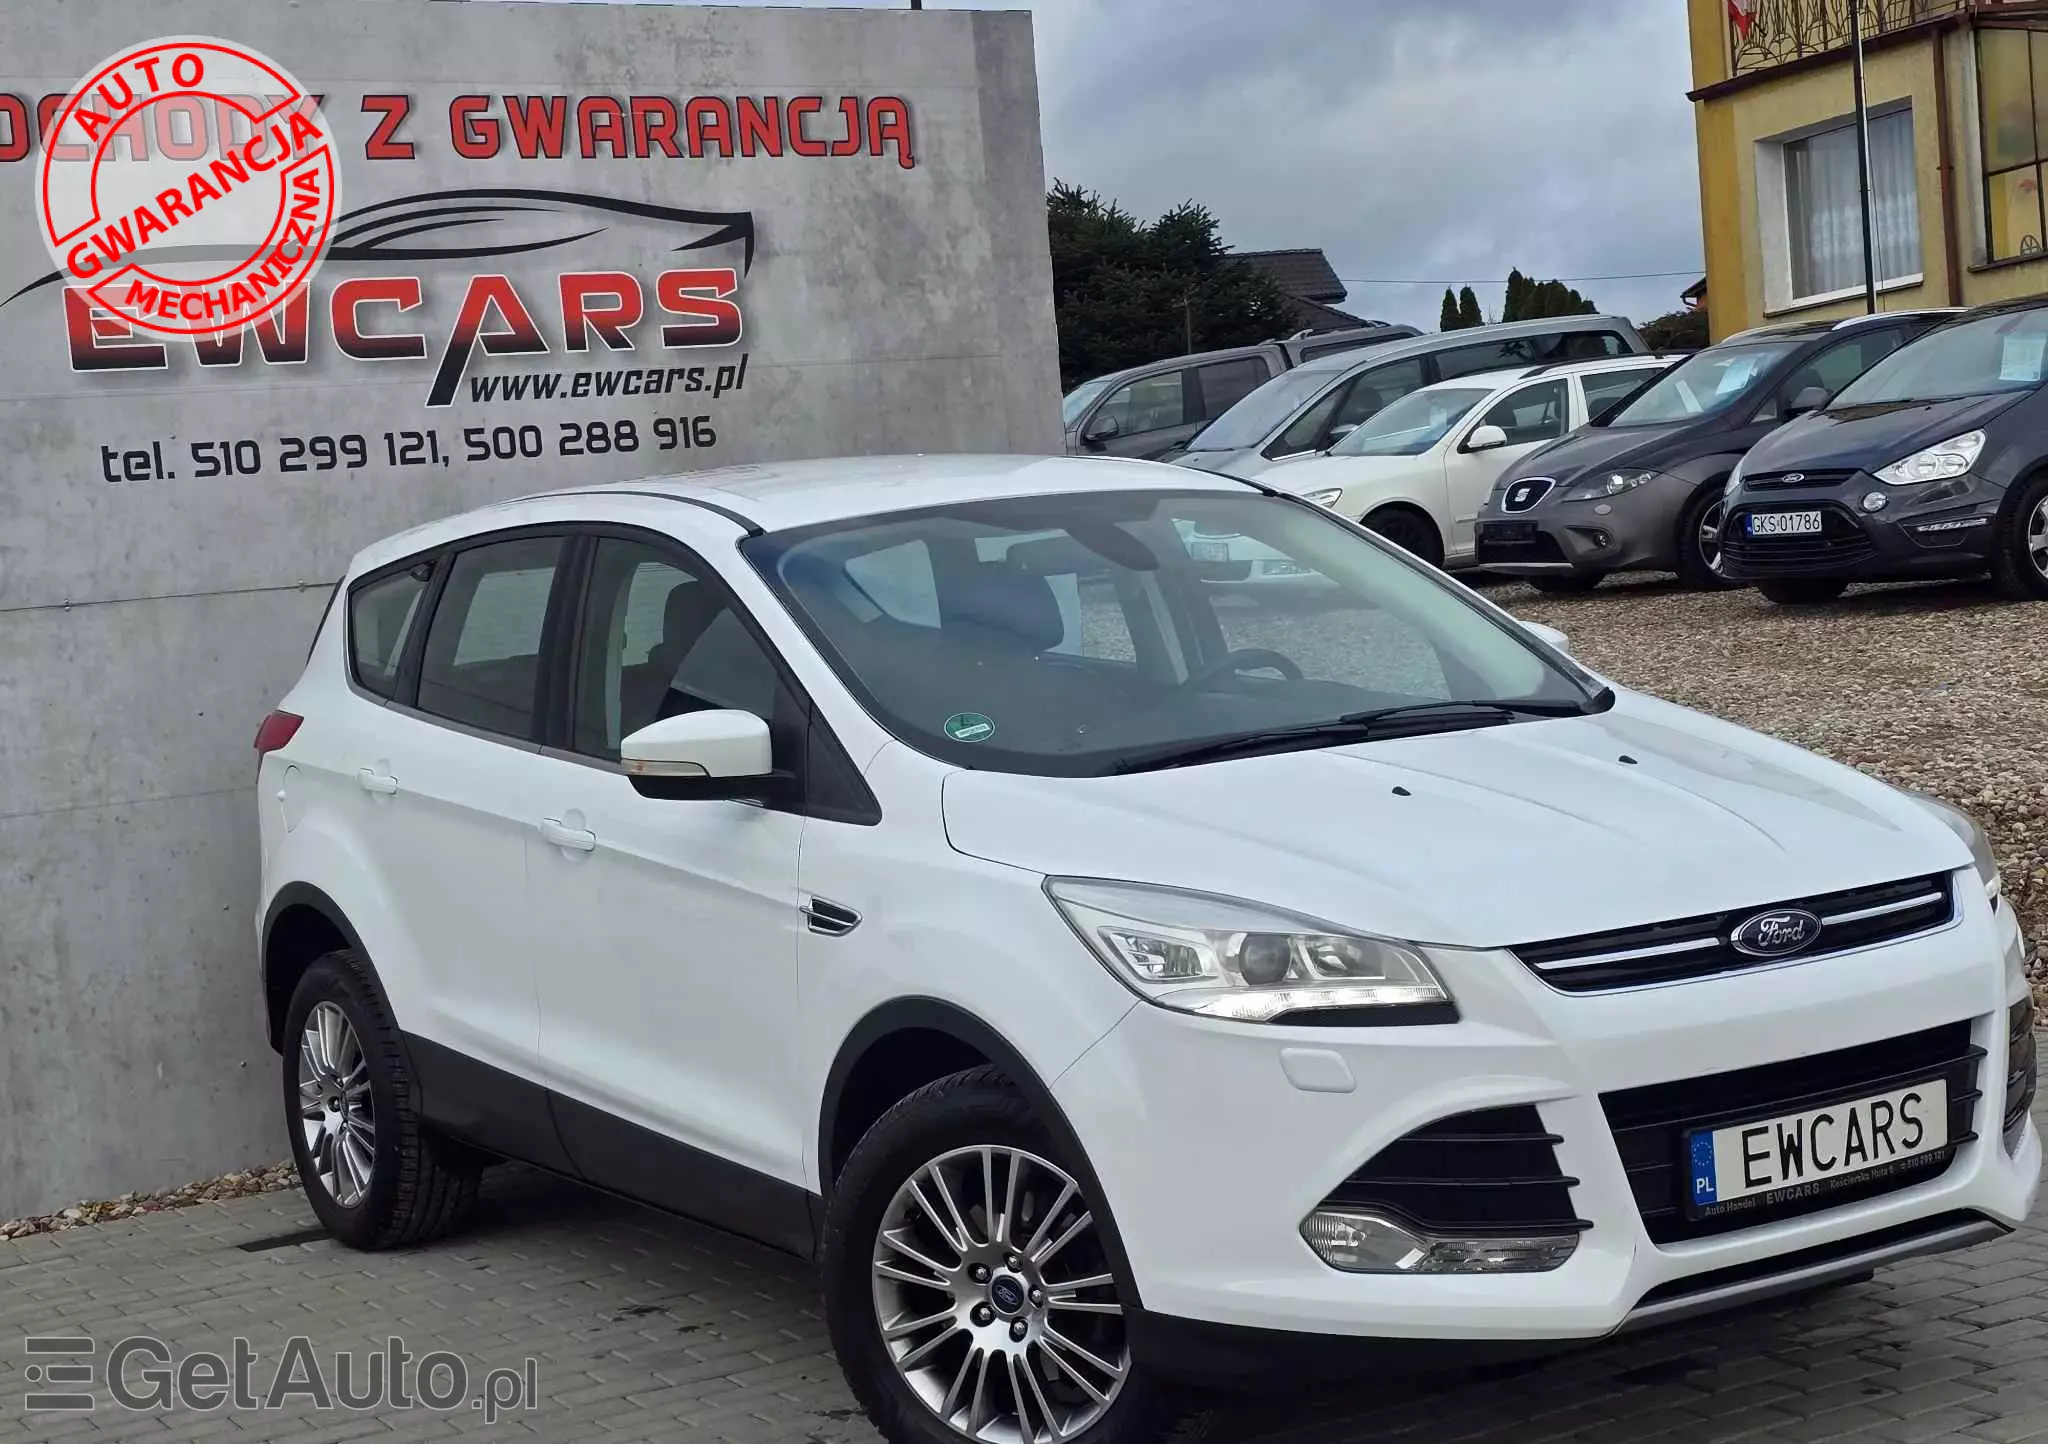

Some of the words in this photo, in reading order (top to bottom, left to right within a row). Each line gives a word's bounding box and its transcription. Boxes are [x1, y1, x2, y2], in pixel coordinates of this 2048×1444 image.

[360, 94, 416, 160] Z
[448, 95, 916, 170] GWARANCJĄ
[62, 267, 743, 407] EWCARS
[470, 353, 749, 402] www.ewcars.pl
[101, 441, 176, 483] tel.
[192, 439, 262, 478] 510
[279, 434, 368, 473] 299
[383, 429, 449, 470] 121,
[463, 422, 542, 462] 500
[559, 418, 640, 457] 288
[652, 414, 717, 451] 916
[1758, 915, 1805, 947] Ford
[1741, 1092, 1924, 1189] EWCARS
[1695, 1176, 1715, 1195] PL
[1766, 1182, 1821, 1206] EWCARS
